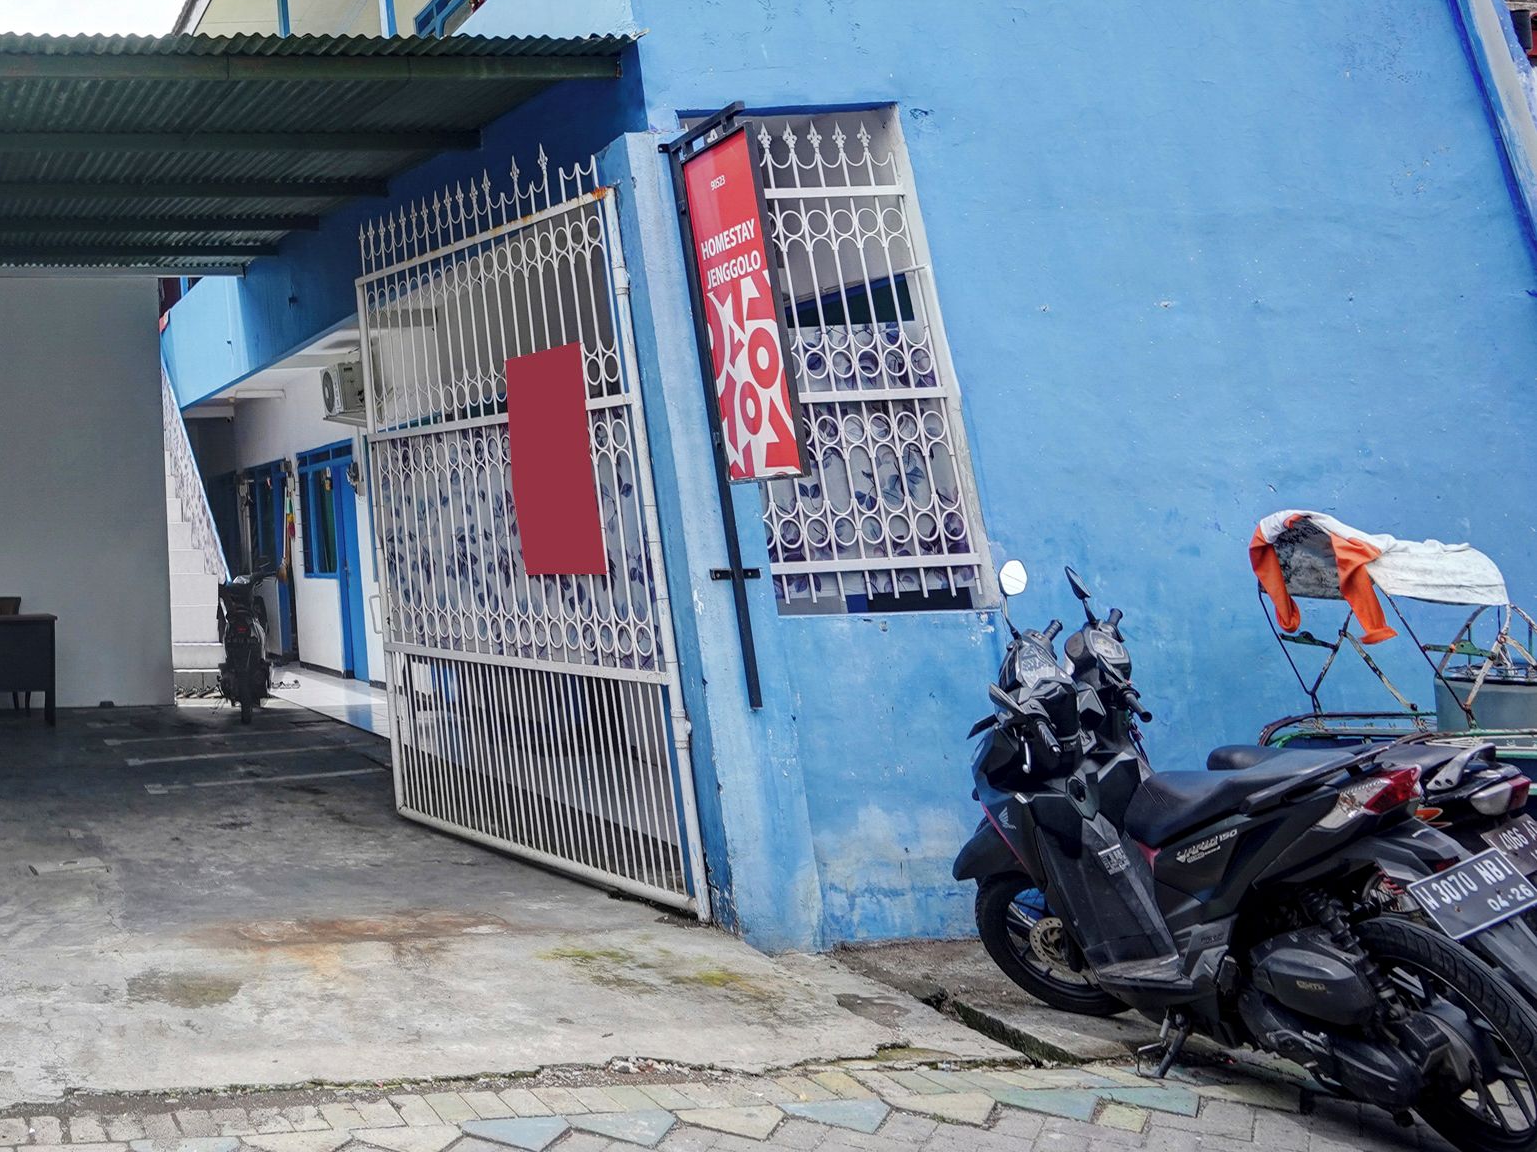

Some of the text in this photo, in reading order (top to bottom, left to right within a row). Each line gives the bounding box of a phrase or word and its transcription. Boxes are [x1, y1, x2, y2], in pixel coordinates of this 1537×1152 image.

[701, 218, 755, 260] HOMESTAY
[707, 250, 761, 289] JENGGOLO
[1415, 886, 1440, 911] W
[1431, 870, 1478, 905] 3070
